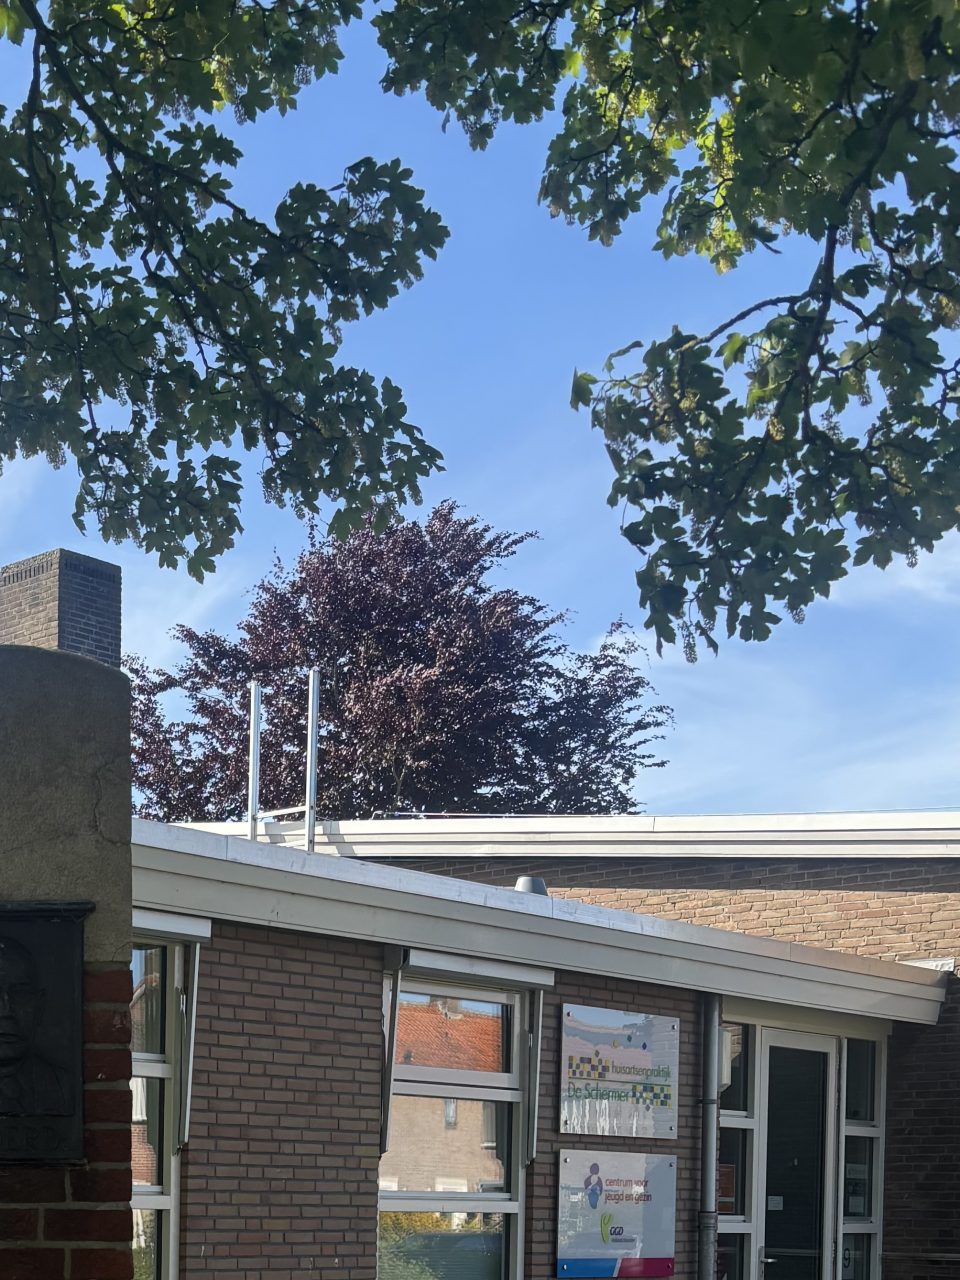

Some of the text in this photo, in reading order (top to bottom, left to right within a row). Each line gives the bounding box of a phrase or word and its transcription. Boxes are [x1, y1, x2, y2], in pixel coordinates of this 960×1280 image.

[611, 1060, 671, 1082] huisartsenpraktijk
[567, 1081, 629, 1101] De Schermer
[605, 1178, 633, 1187] centrum
[604, 1191, 653, 1205] jeugd en gezin
[610, 1226, 624, 1235] GGD
